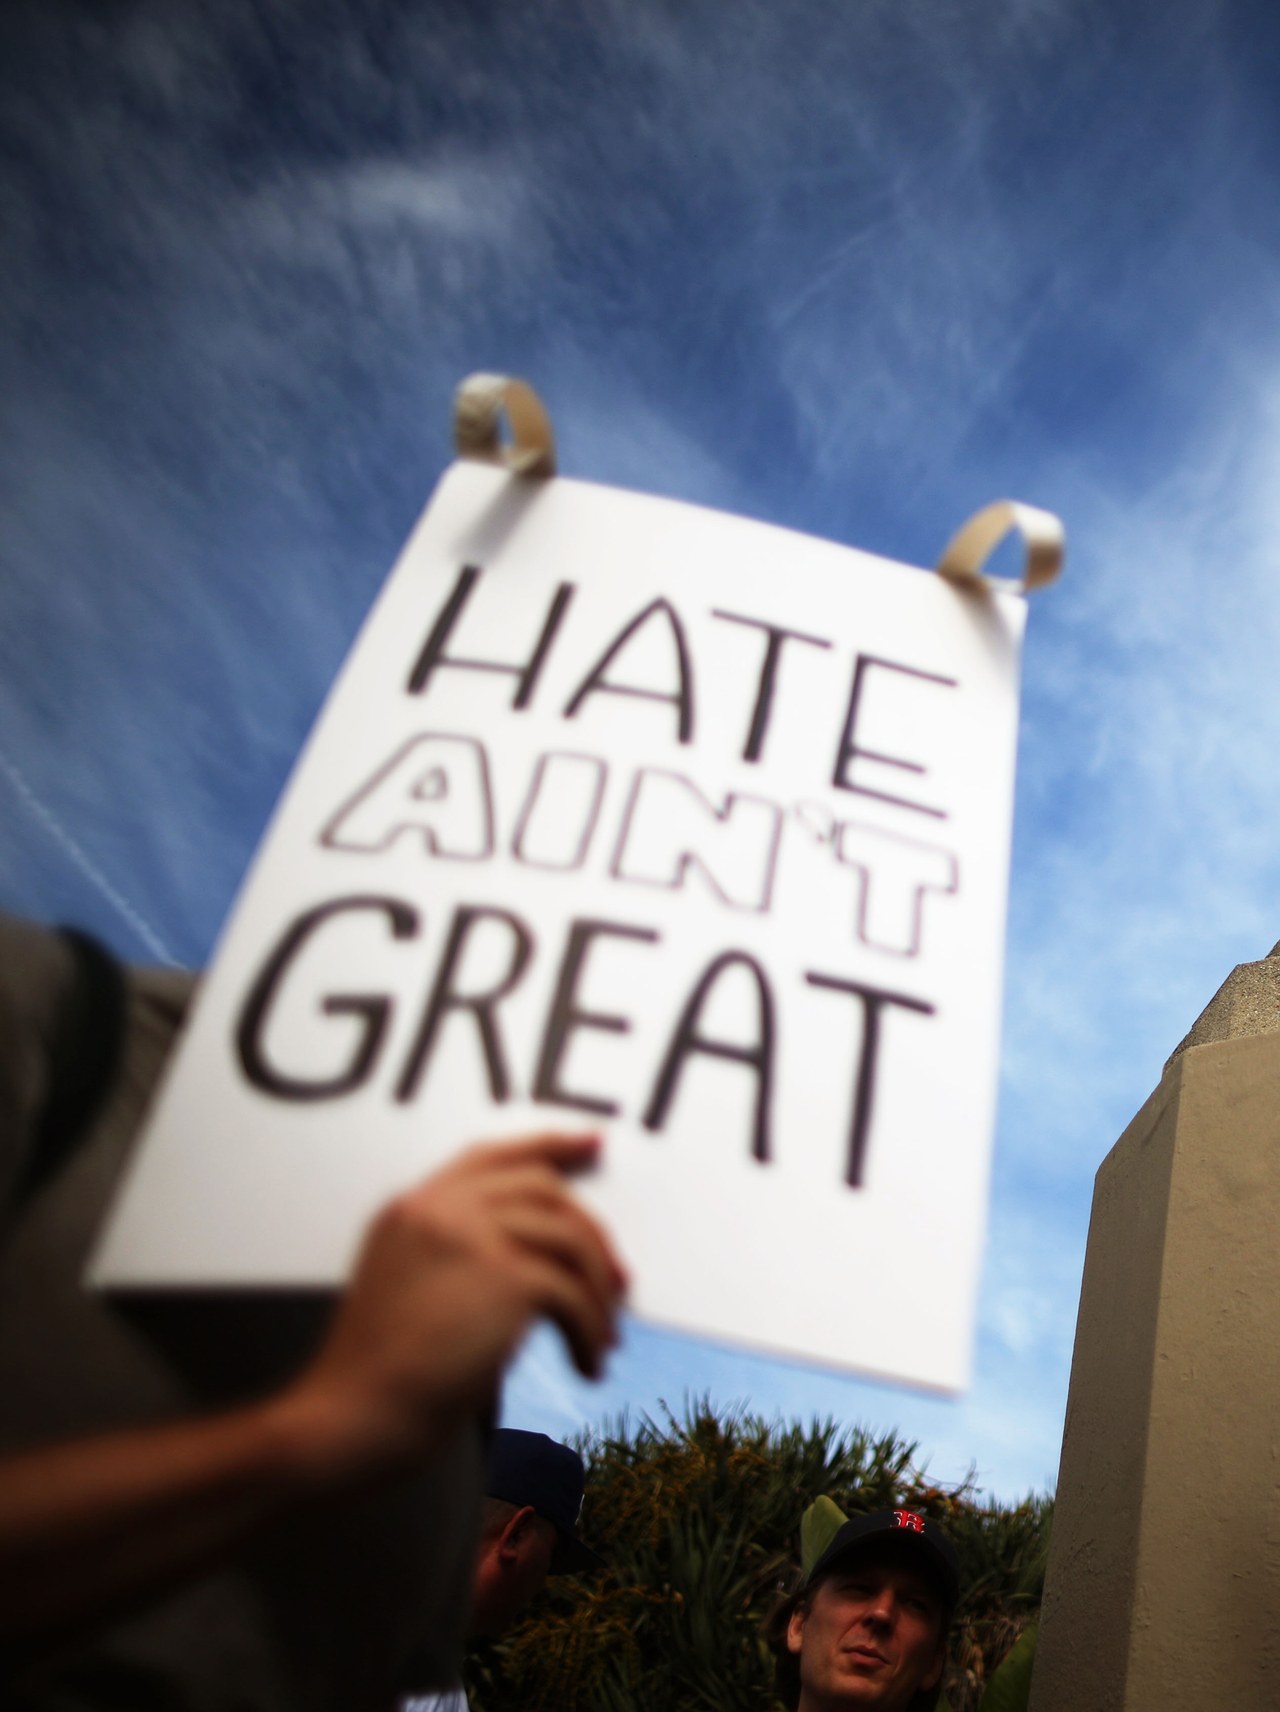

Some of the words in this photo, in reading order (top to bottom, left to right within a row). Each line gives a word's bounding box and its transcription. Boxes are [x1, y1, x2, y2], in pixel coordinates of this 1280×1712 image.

[404, 563, 960, 821] HATE
[318, 730, 960, 959] AIN'T
[233, 893, 937, 1192] GREAT
